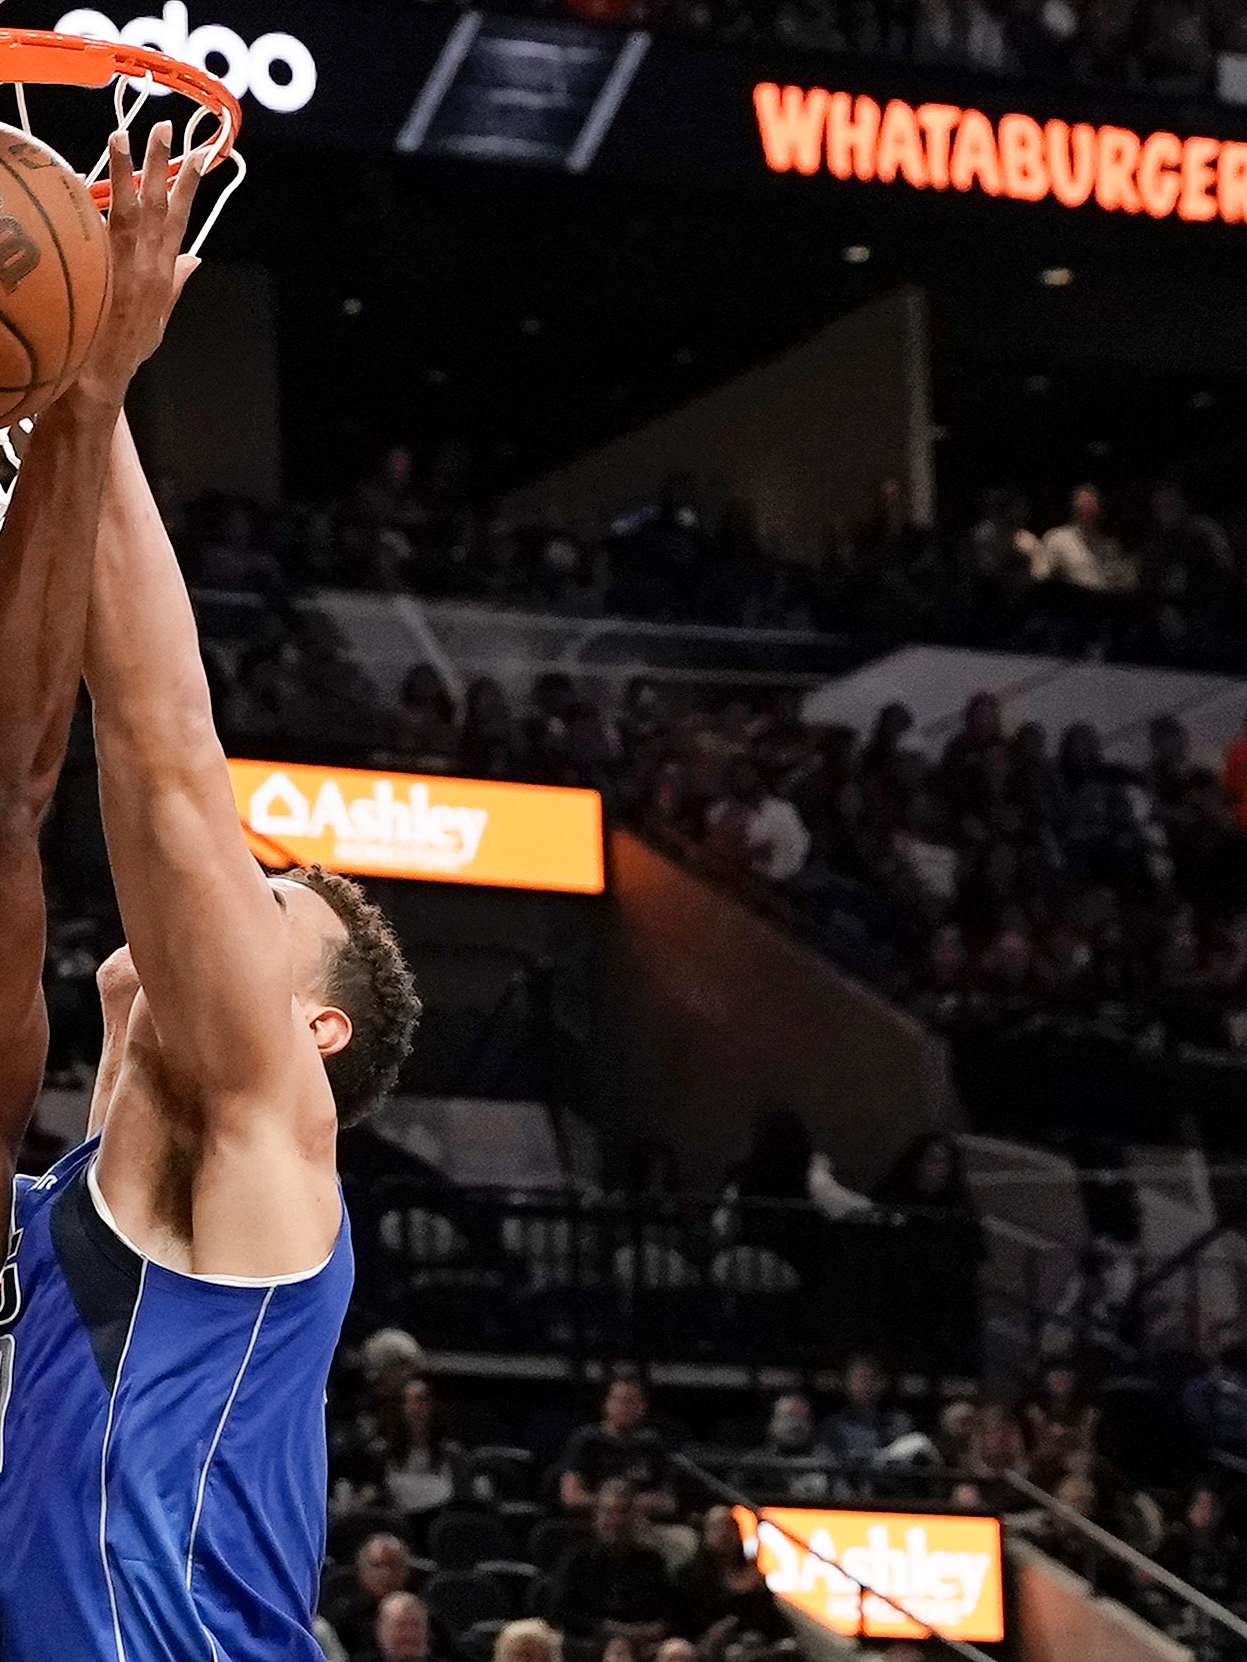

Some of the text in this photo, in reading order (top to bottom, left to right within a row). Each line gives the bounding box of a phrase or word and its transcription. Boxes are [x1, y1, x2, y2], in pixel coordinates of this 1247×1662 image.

[754, 77, 1247, 224] WHATABURGER
[308, 779, 489, 864] Ashley
[800, 1524, 991, 1616] Ashley
